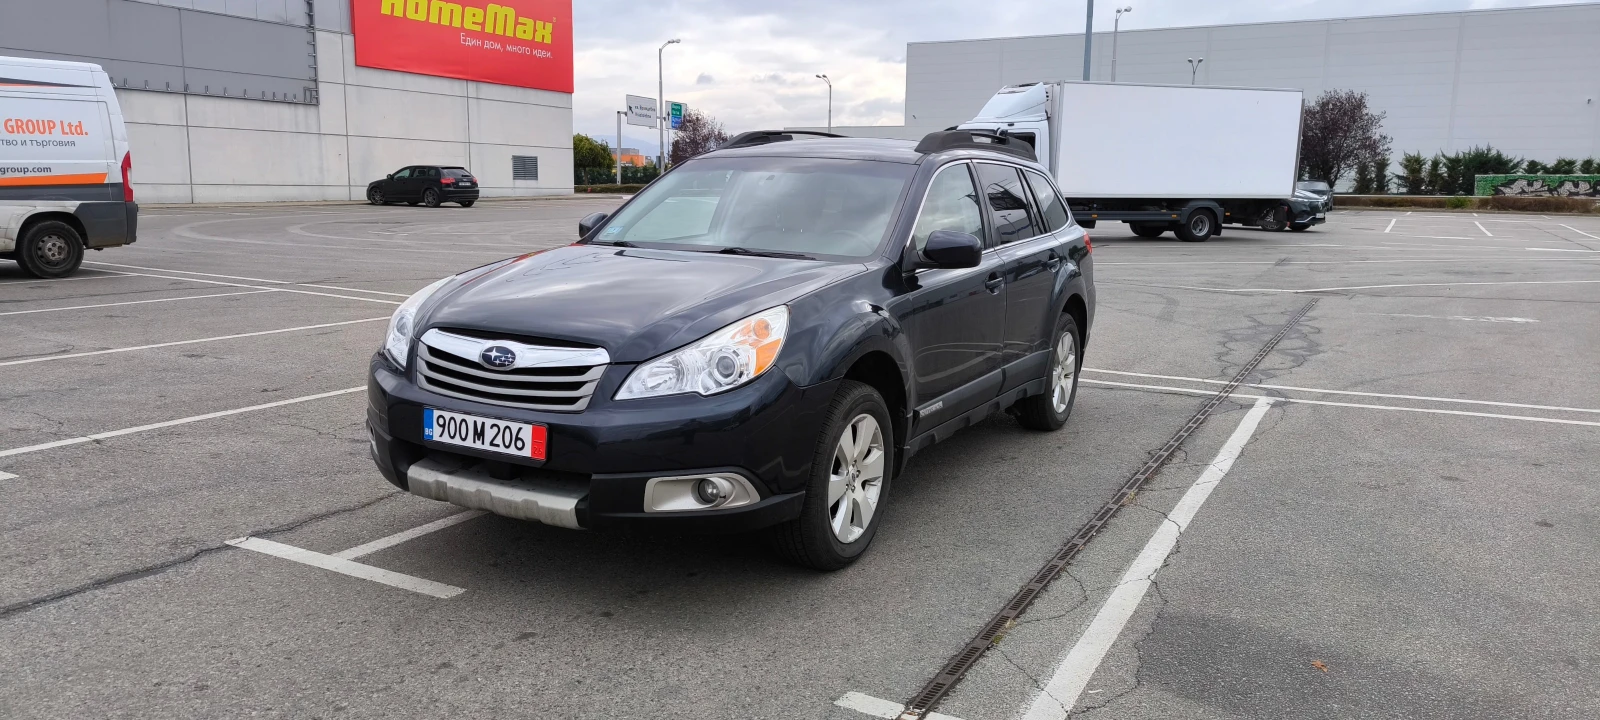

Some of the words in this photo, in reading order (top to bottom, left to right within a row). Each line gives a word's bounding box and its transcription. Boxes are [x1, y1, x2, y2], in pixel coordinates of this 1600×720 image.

[460, 33, 482, 47] Един
[484, 40, 503, 52] дом,
[506, 44, 531, 55] много
[533, 49, 553, 59] идеи.
[3, 118, 57, 135] GROUP
[60, 120, 89, 136] Ltd.
[21, 139, 27, 147] и
[29, 139, 76, 149] търговия
[424, 427, 433, 436] BG
[436, 414, 470, 442] 900
[473, 420, 486, 446] M
[489, 423, 526, 451] 206
